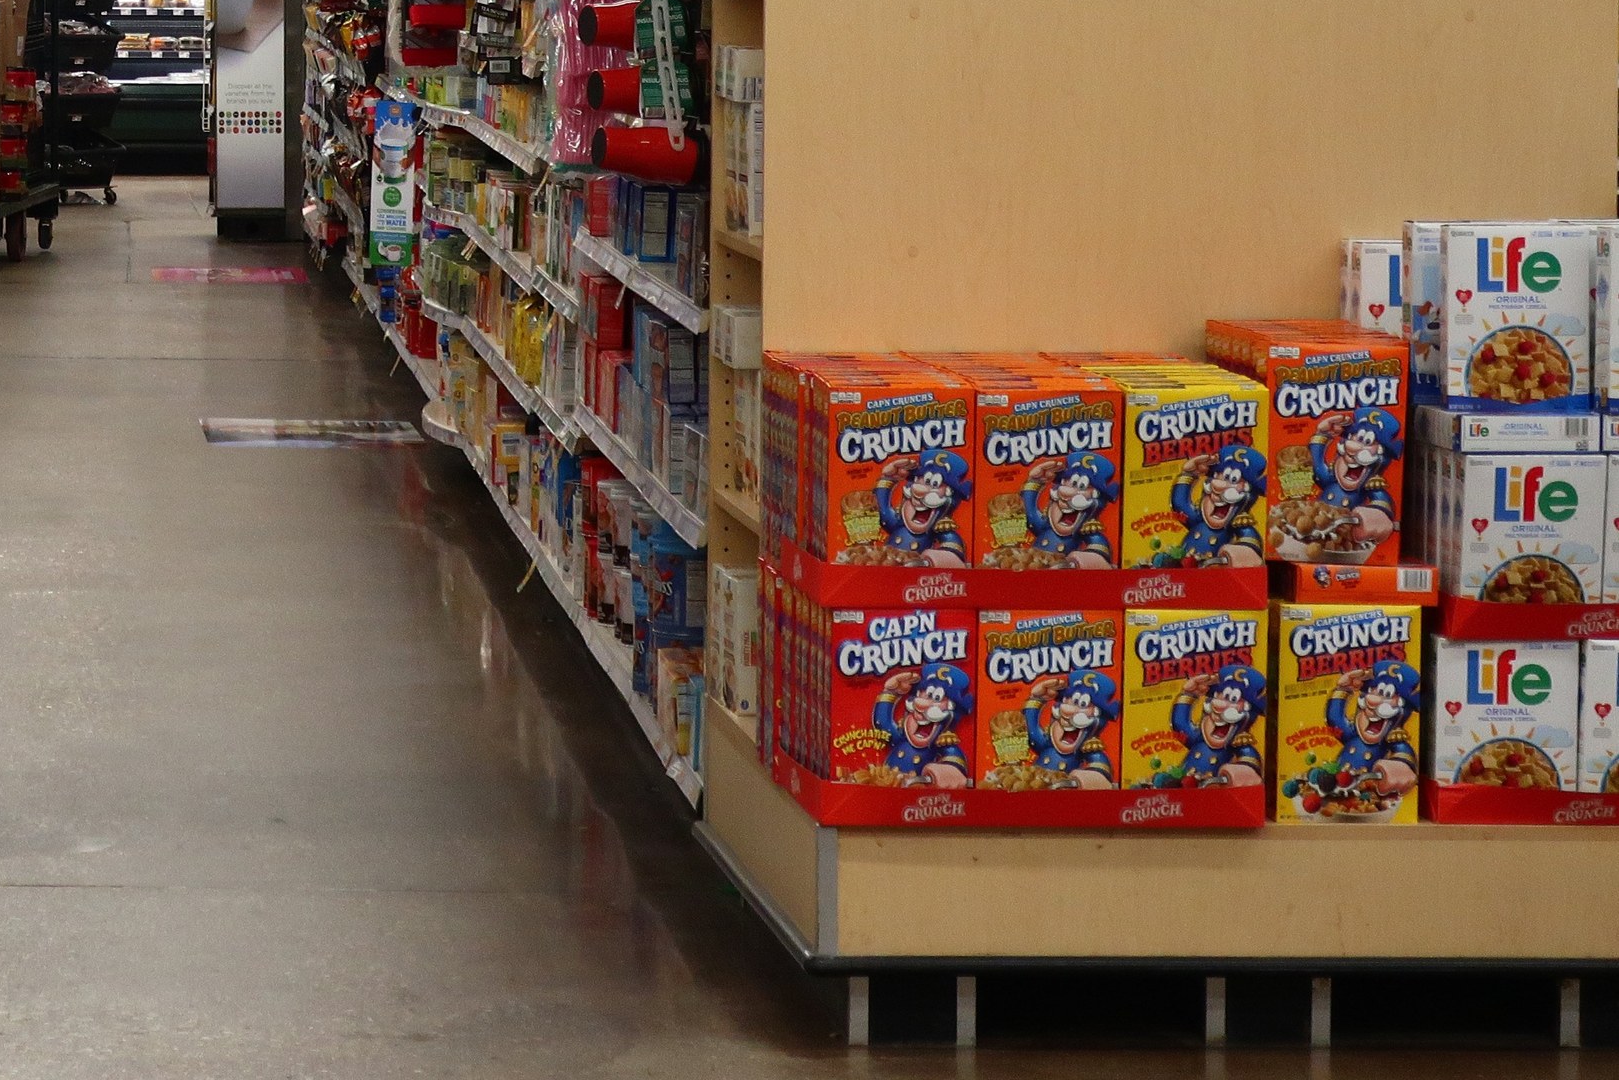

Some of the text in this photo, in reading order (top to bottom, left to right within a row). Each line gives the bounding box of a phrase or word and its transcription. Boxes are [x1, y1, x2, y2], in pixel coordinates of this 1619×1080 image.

[1477, 236, 1562, 293] Life
[837, 400, 967, 432] PEANUT BUTTER
